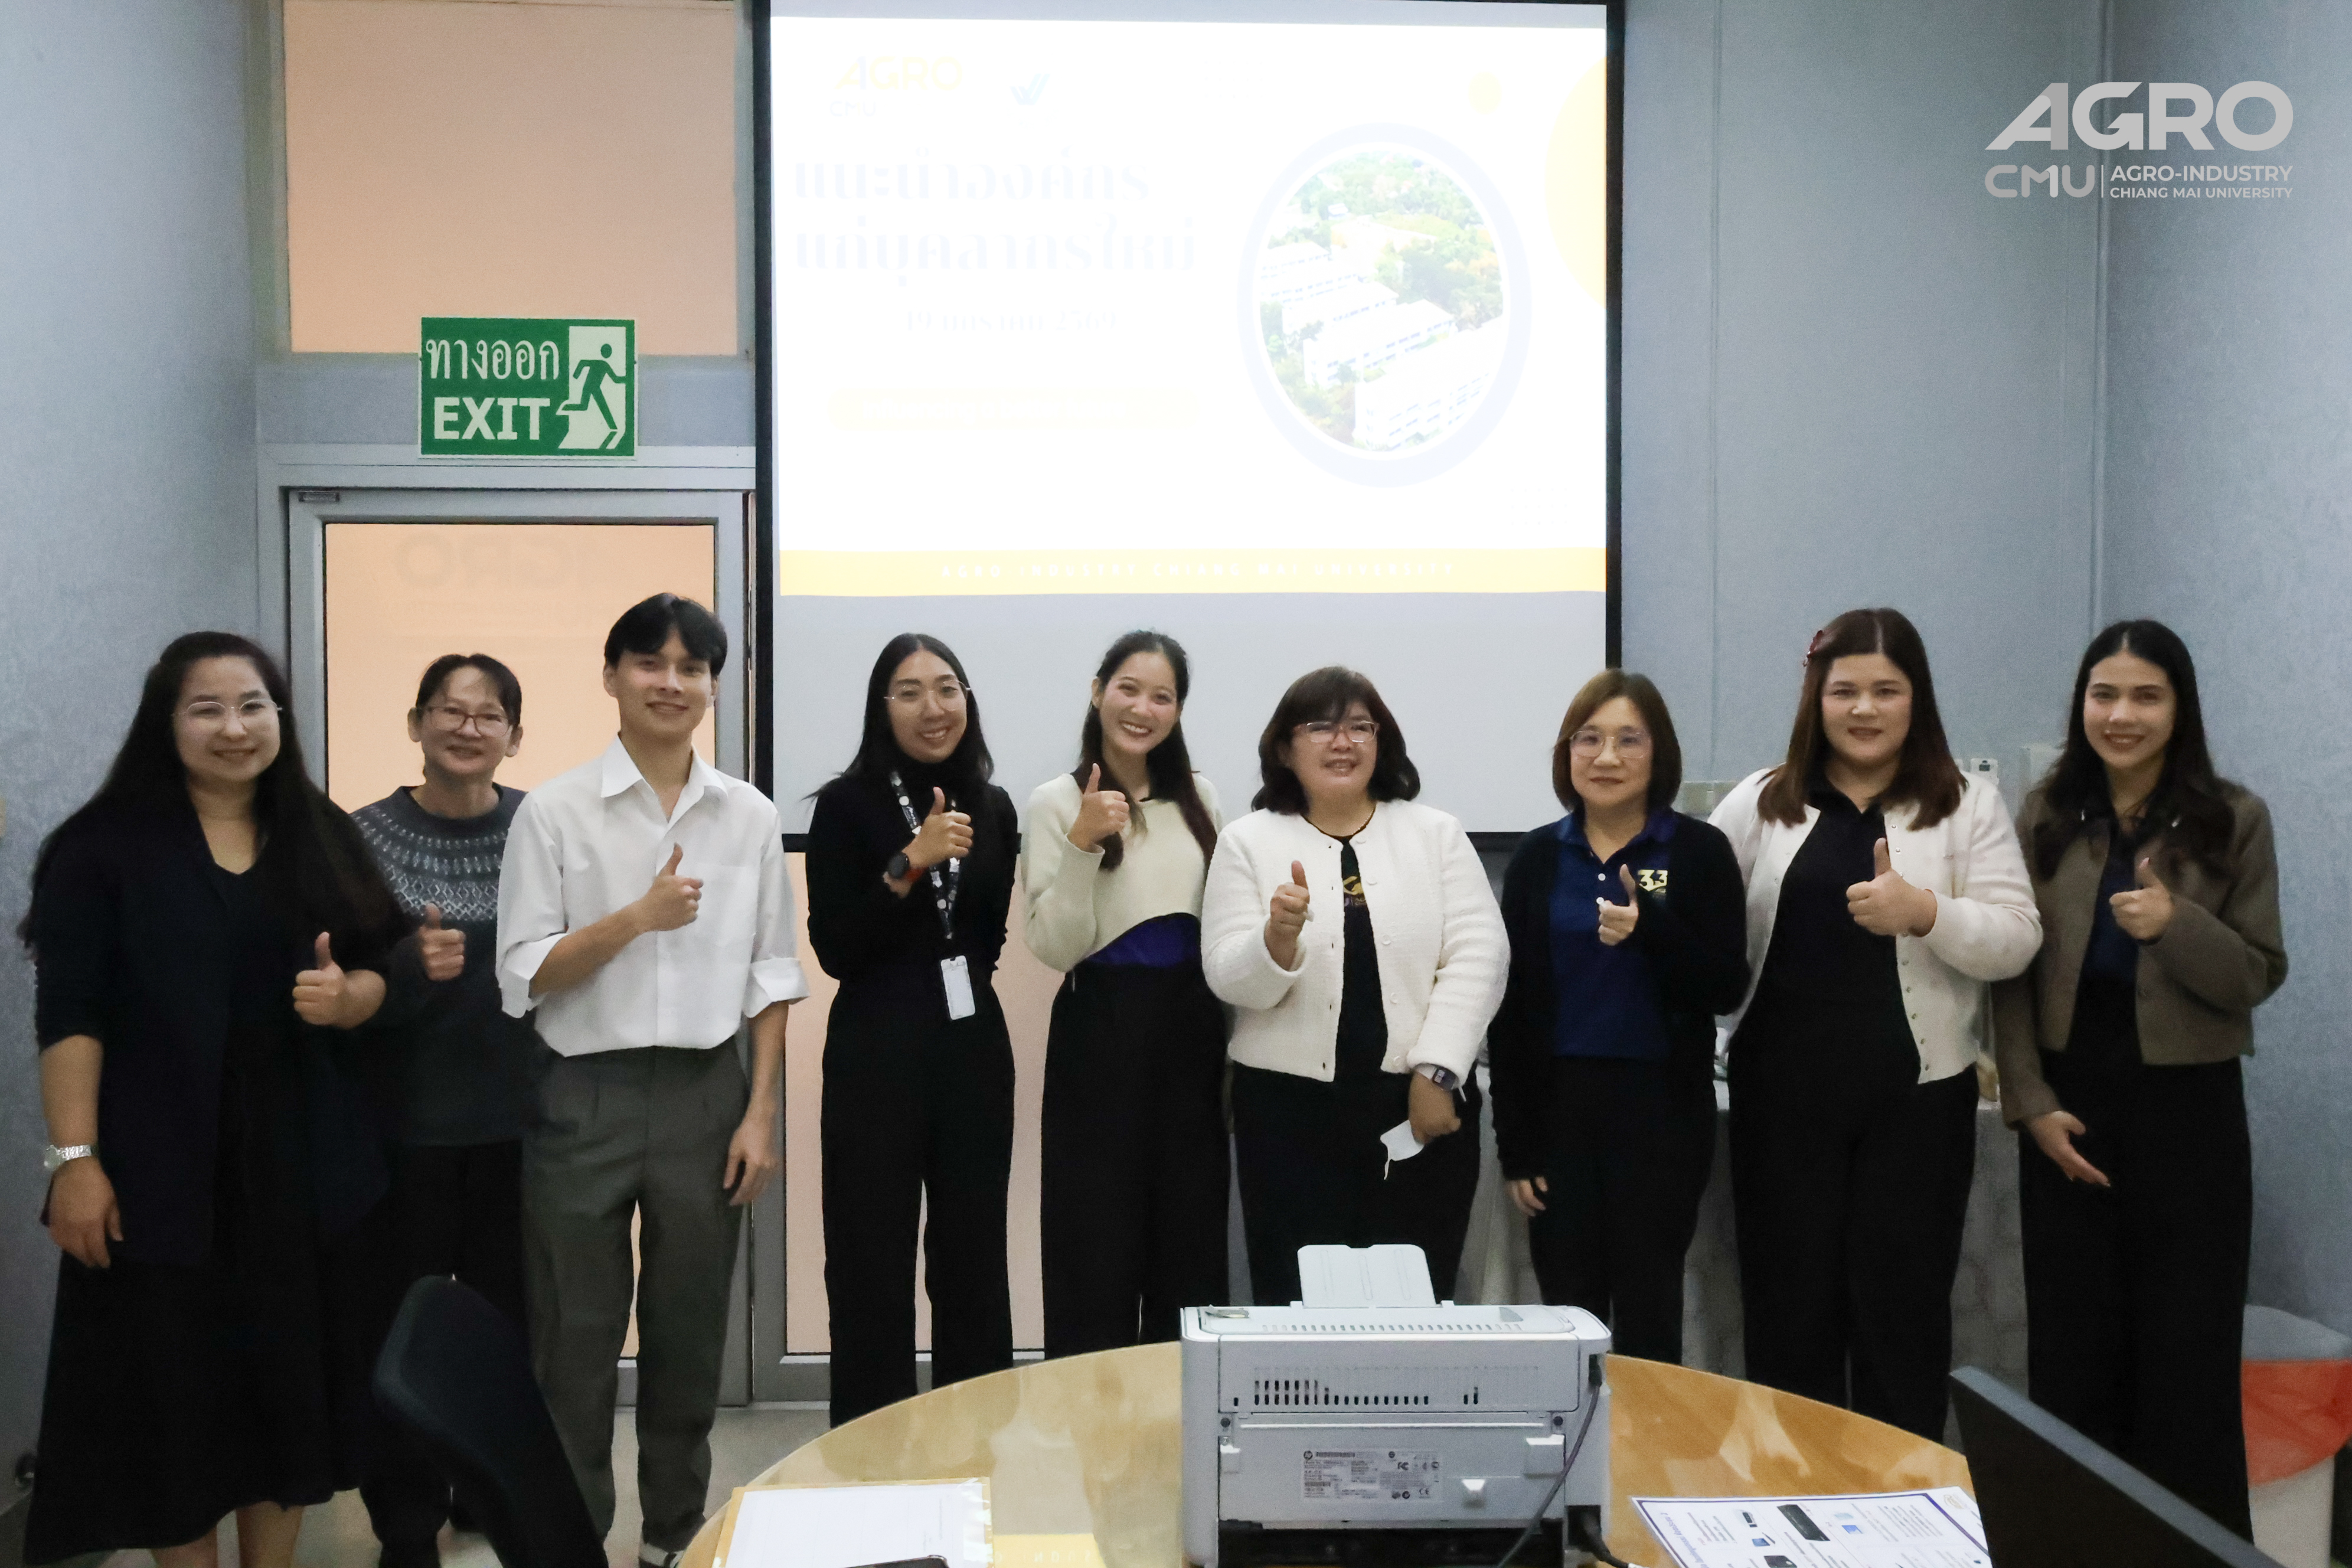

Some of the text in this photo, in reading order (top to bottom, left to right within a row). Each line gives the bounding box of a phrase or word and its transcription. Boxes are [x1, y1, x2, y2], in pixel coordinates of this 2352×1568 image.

[834, 56, 963, 91] AGRO
[829, 100, 877, 117] CMU
[796, 145, 1149, 200] แนะนำองค์กร
[797, 213, 1195, 287] แก่บุคลากรใหม่
[426, 339, 559, 380] ทางออก
[434, 397, 550, 440] EXIT
[1152, 562, 1240, 577] CHIANG
[1257, 562, 1298, 576] MAI
[1314, 561, 1453, 577] UNIVERSITY
